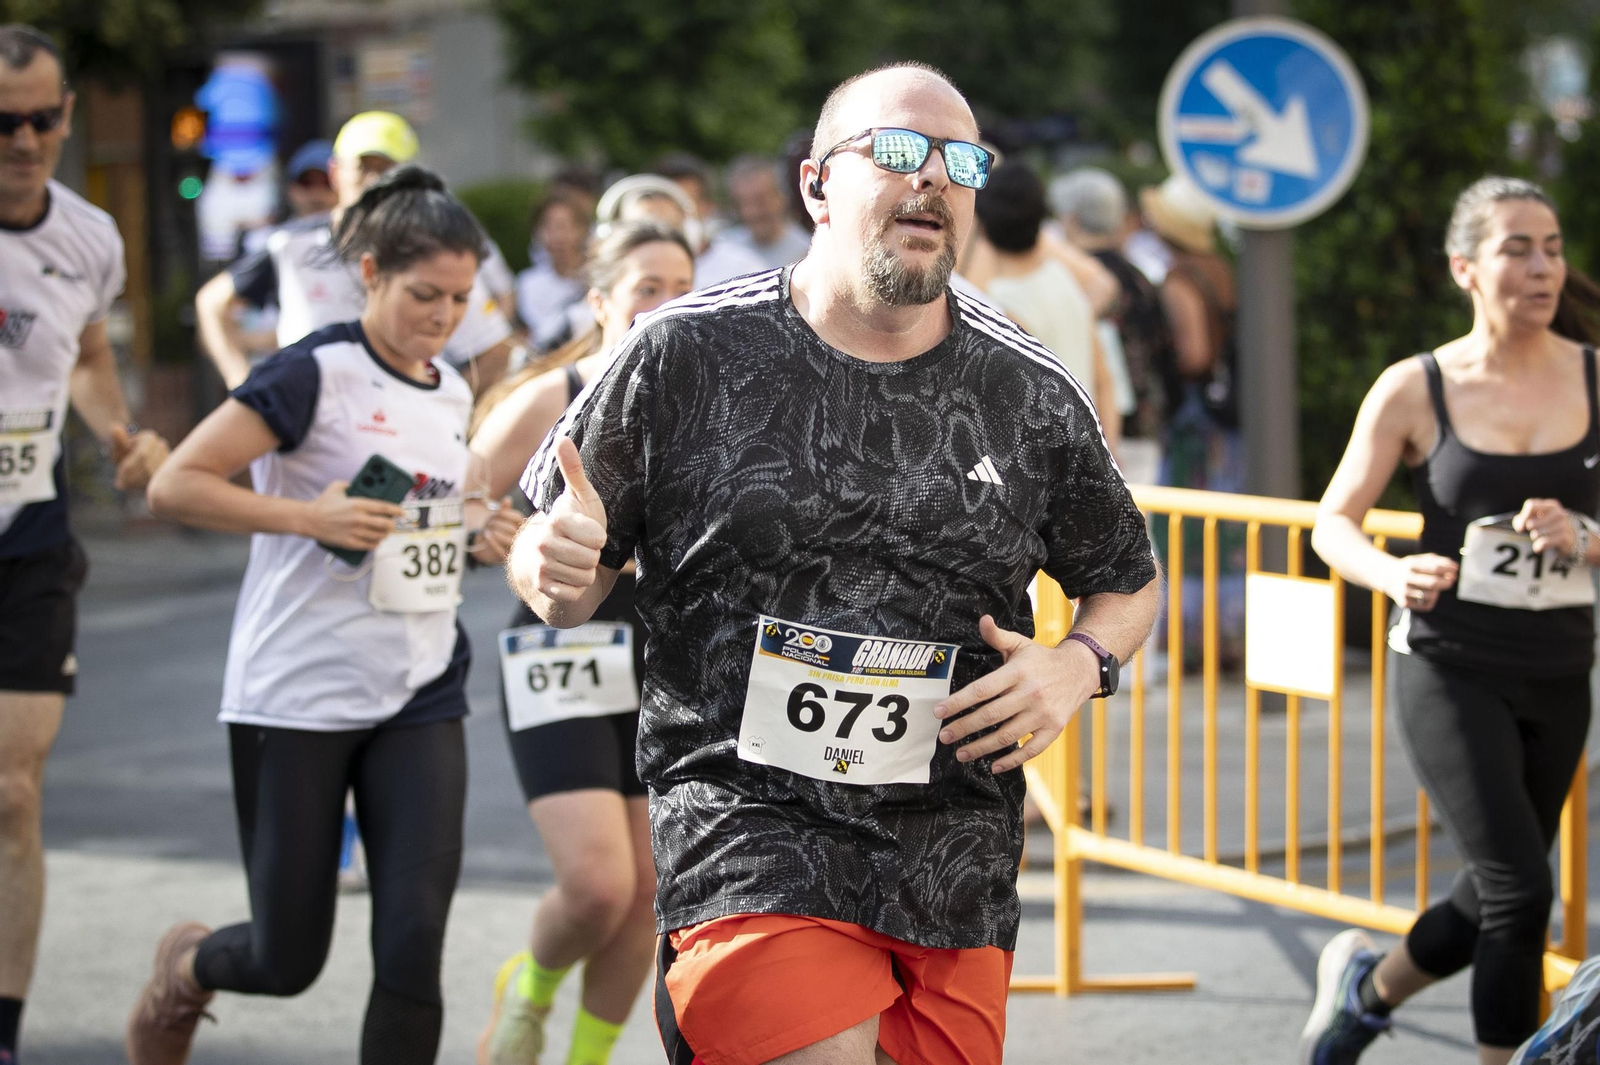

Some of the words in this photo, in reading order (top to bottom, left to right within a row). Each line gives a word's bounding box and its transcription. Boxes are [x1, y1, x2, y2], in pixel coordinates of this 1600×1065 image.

[402, 541, 458, 579] 382
[784, 628, 833, 653] 200
[781, 651, 829, 667] NACIONAL
[851, 640, 937, 670] GRANADA
[527, 658, 601, 693] 671
[808, 669, 820, 678] SIN
[822, 672, 845, 682] PRISA
[846, 675, 864, 685] PERO
[866, 677, 881, 686] CON
[881, 678, 899, 688] ALMA
[786, 682, 910, 743] 673
[824, 746, 865, 764] DANIEL
